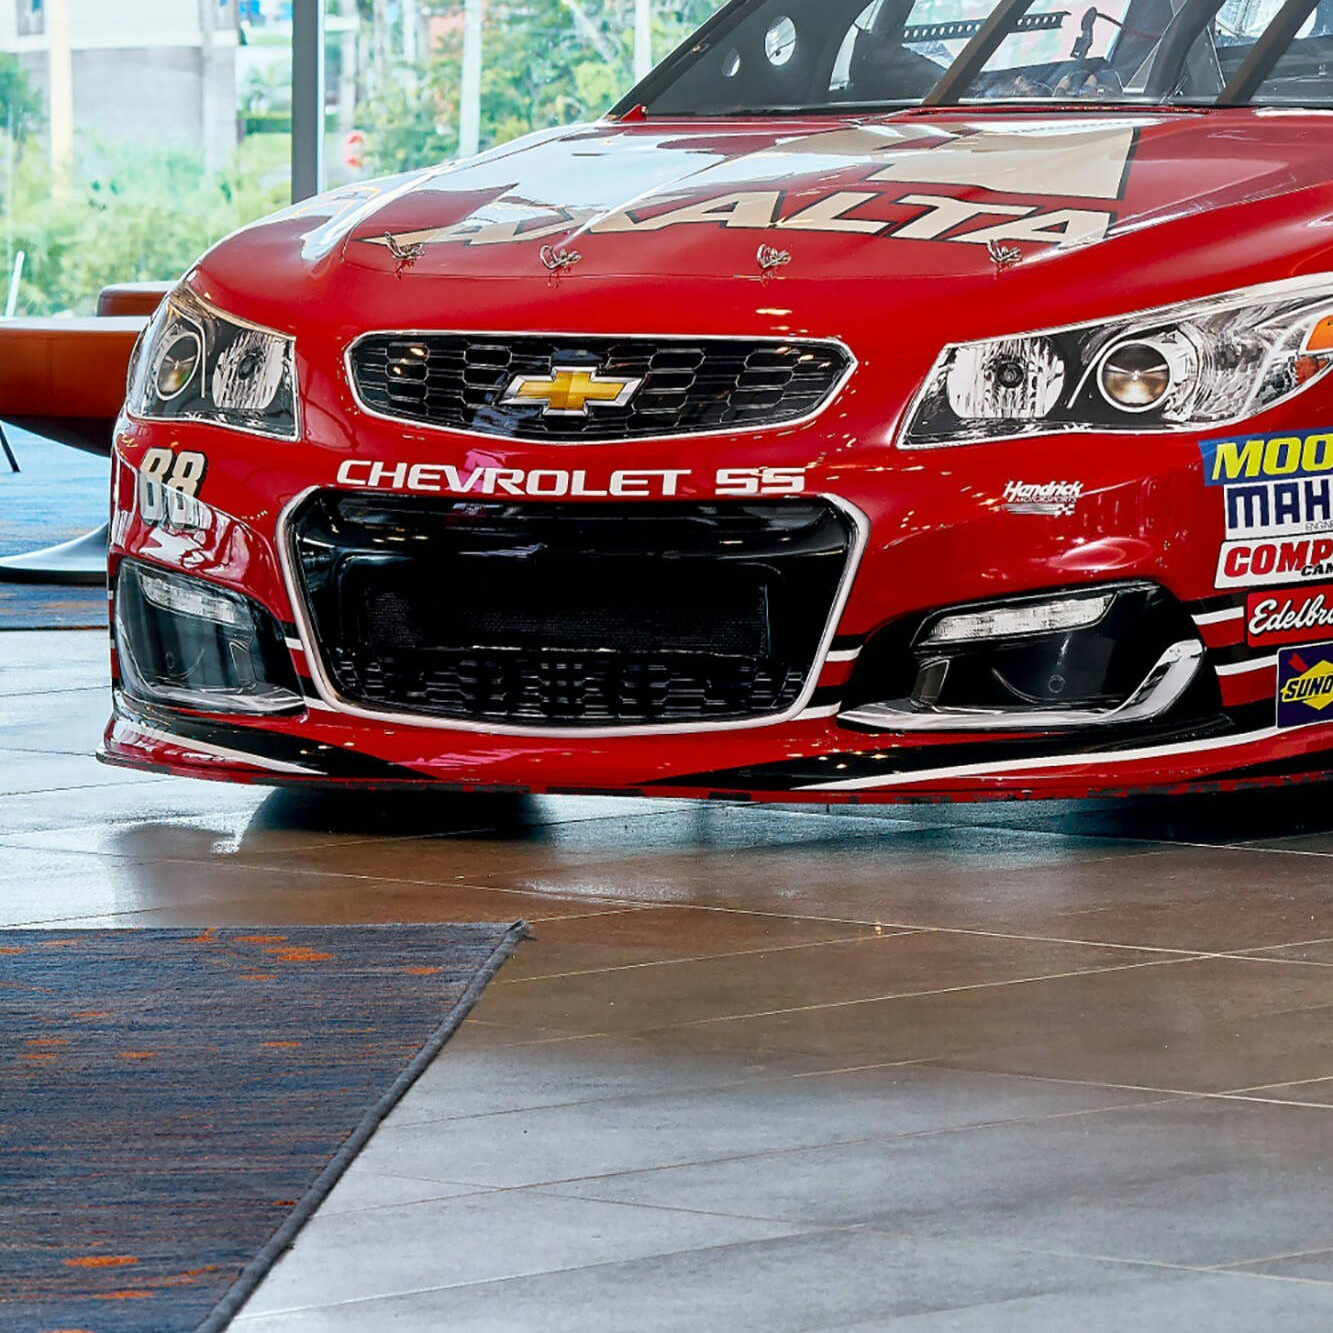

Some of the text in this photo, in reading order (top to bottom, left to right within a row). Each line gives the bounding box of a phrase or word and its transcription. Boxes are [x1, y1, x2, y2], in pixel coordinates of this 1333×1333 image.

[139, 447, 209, 529] 88
[336, 459, 807, 498] CHEVROLET SS
[1002, 479, 1084, 503] Hendrick
